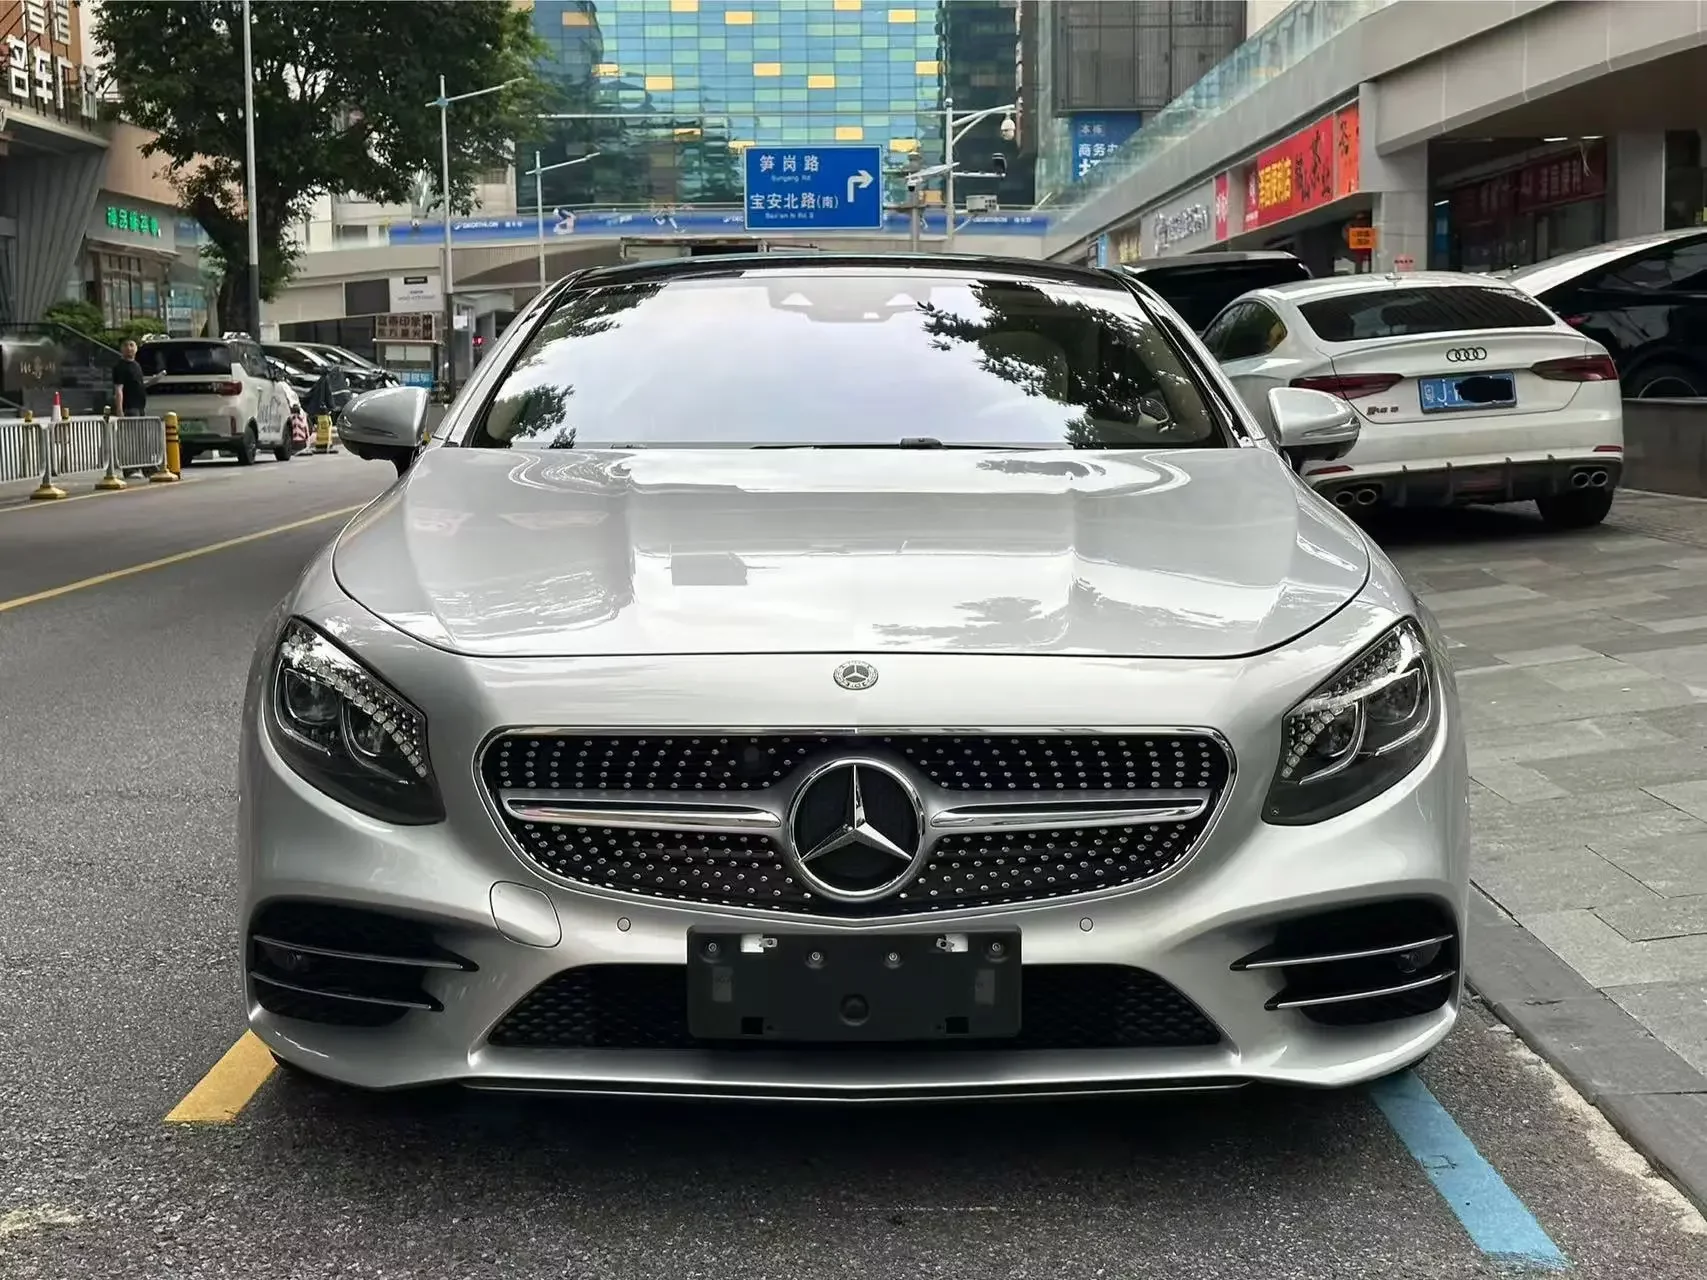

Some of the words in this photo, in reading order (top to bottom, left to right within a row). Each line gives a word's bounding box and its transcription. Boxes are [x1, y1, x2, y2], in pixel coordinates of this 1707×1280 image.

[759, 154, 820, 173] 笋岗路
[749, 192, 839, 210] 宝安北路(南)
